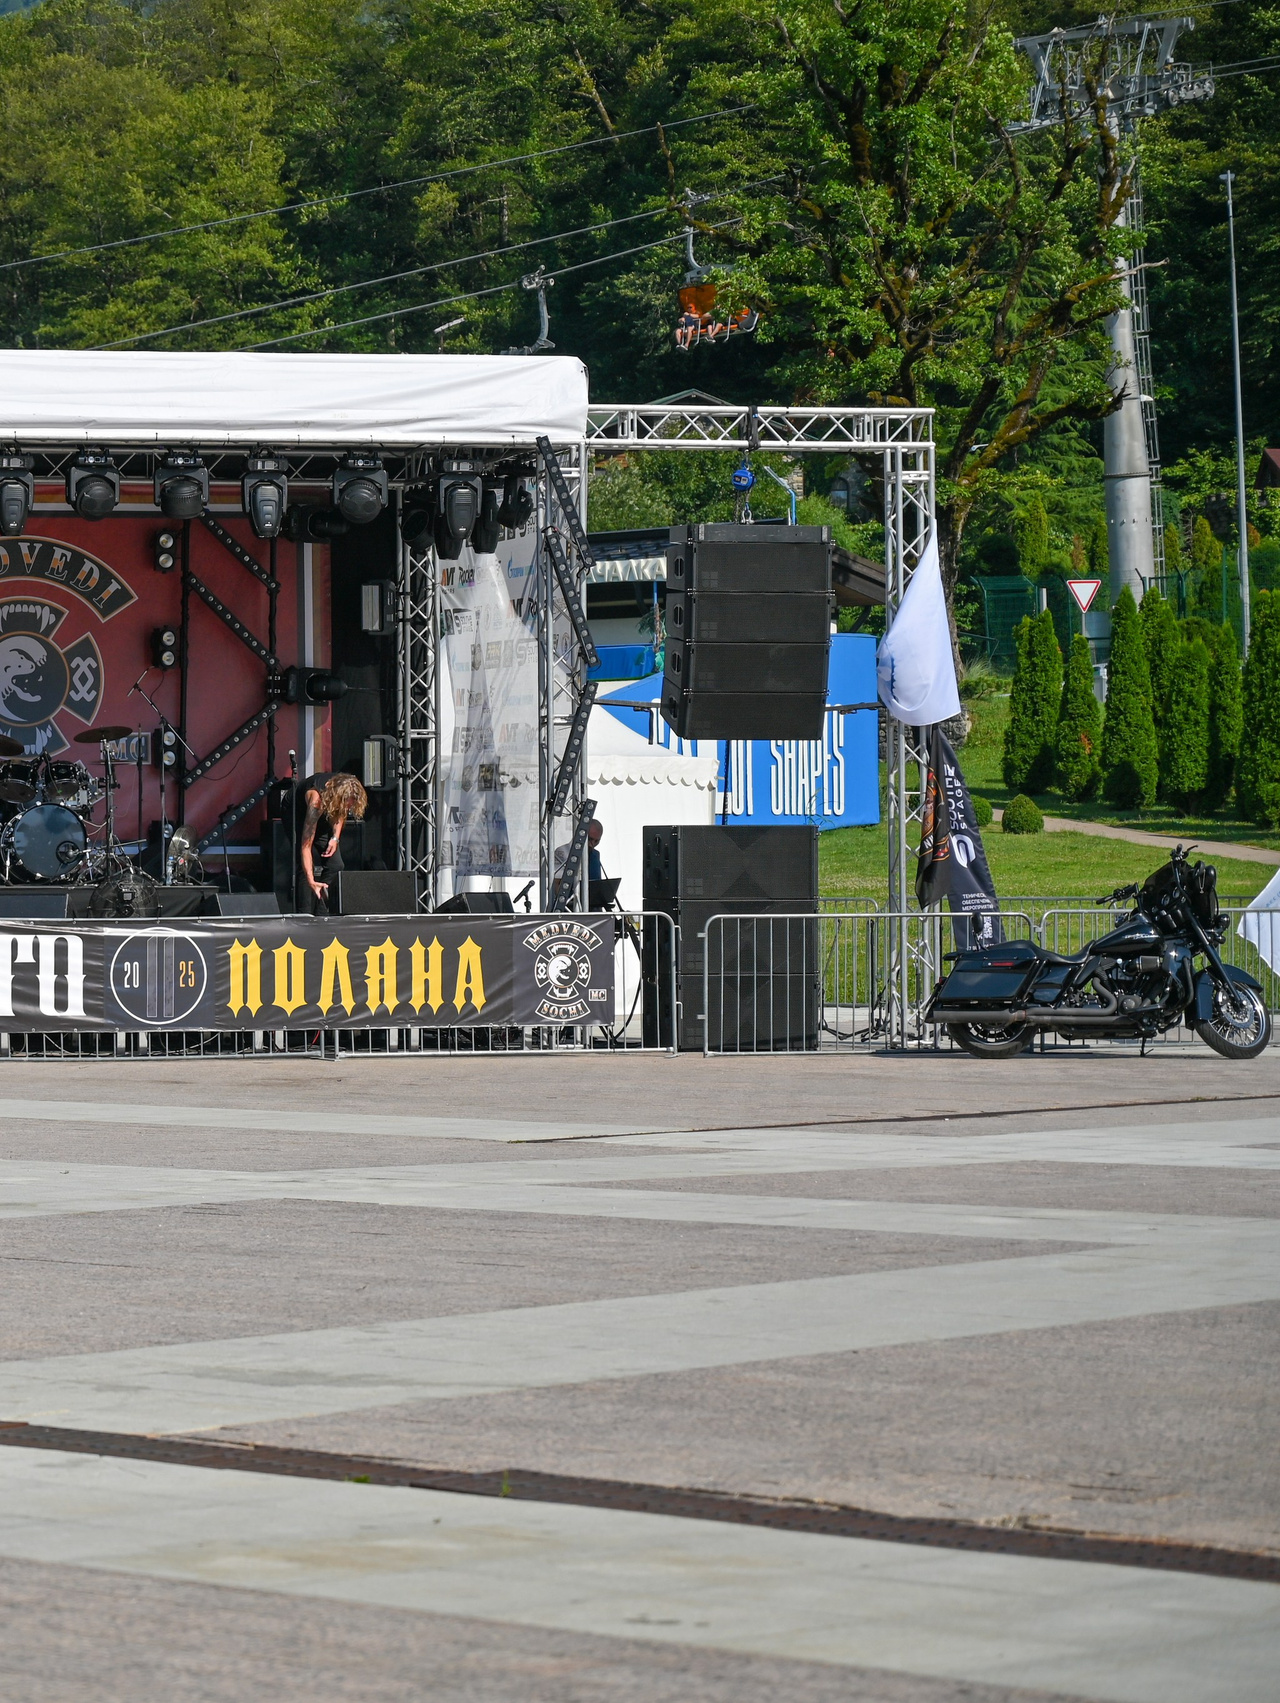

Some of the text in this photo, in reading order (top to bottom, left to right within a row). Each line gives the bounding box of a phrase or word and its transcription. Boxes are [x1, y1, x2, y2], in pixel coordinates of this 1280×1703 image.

[527, 923, 598, 948] MEDVEDI
[124, 961, 139, 988] 20
[179, 960, 195, 987] 25
[226, 935, 487, 1018] ПОЛЯНА
[590, 990, 605, 1000] MC
[540, 1003, 585, 1018] SOCHI
